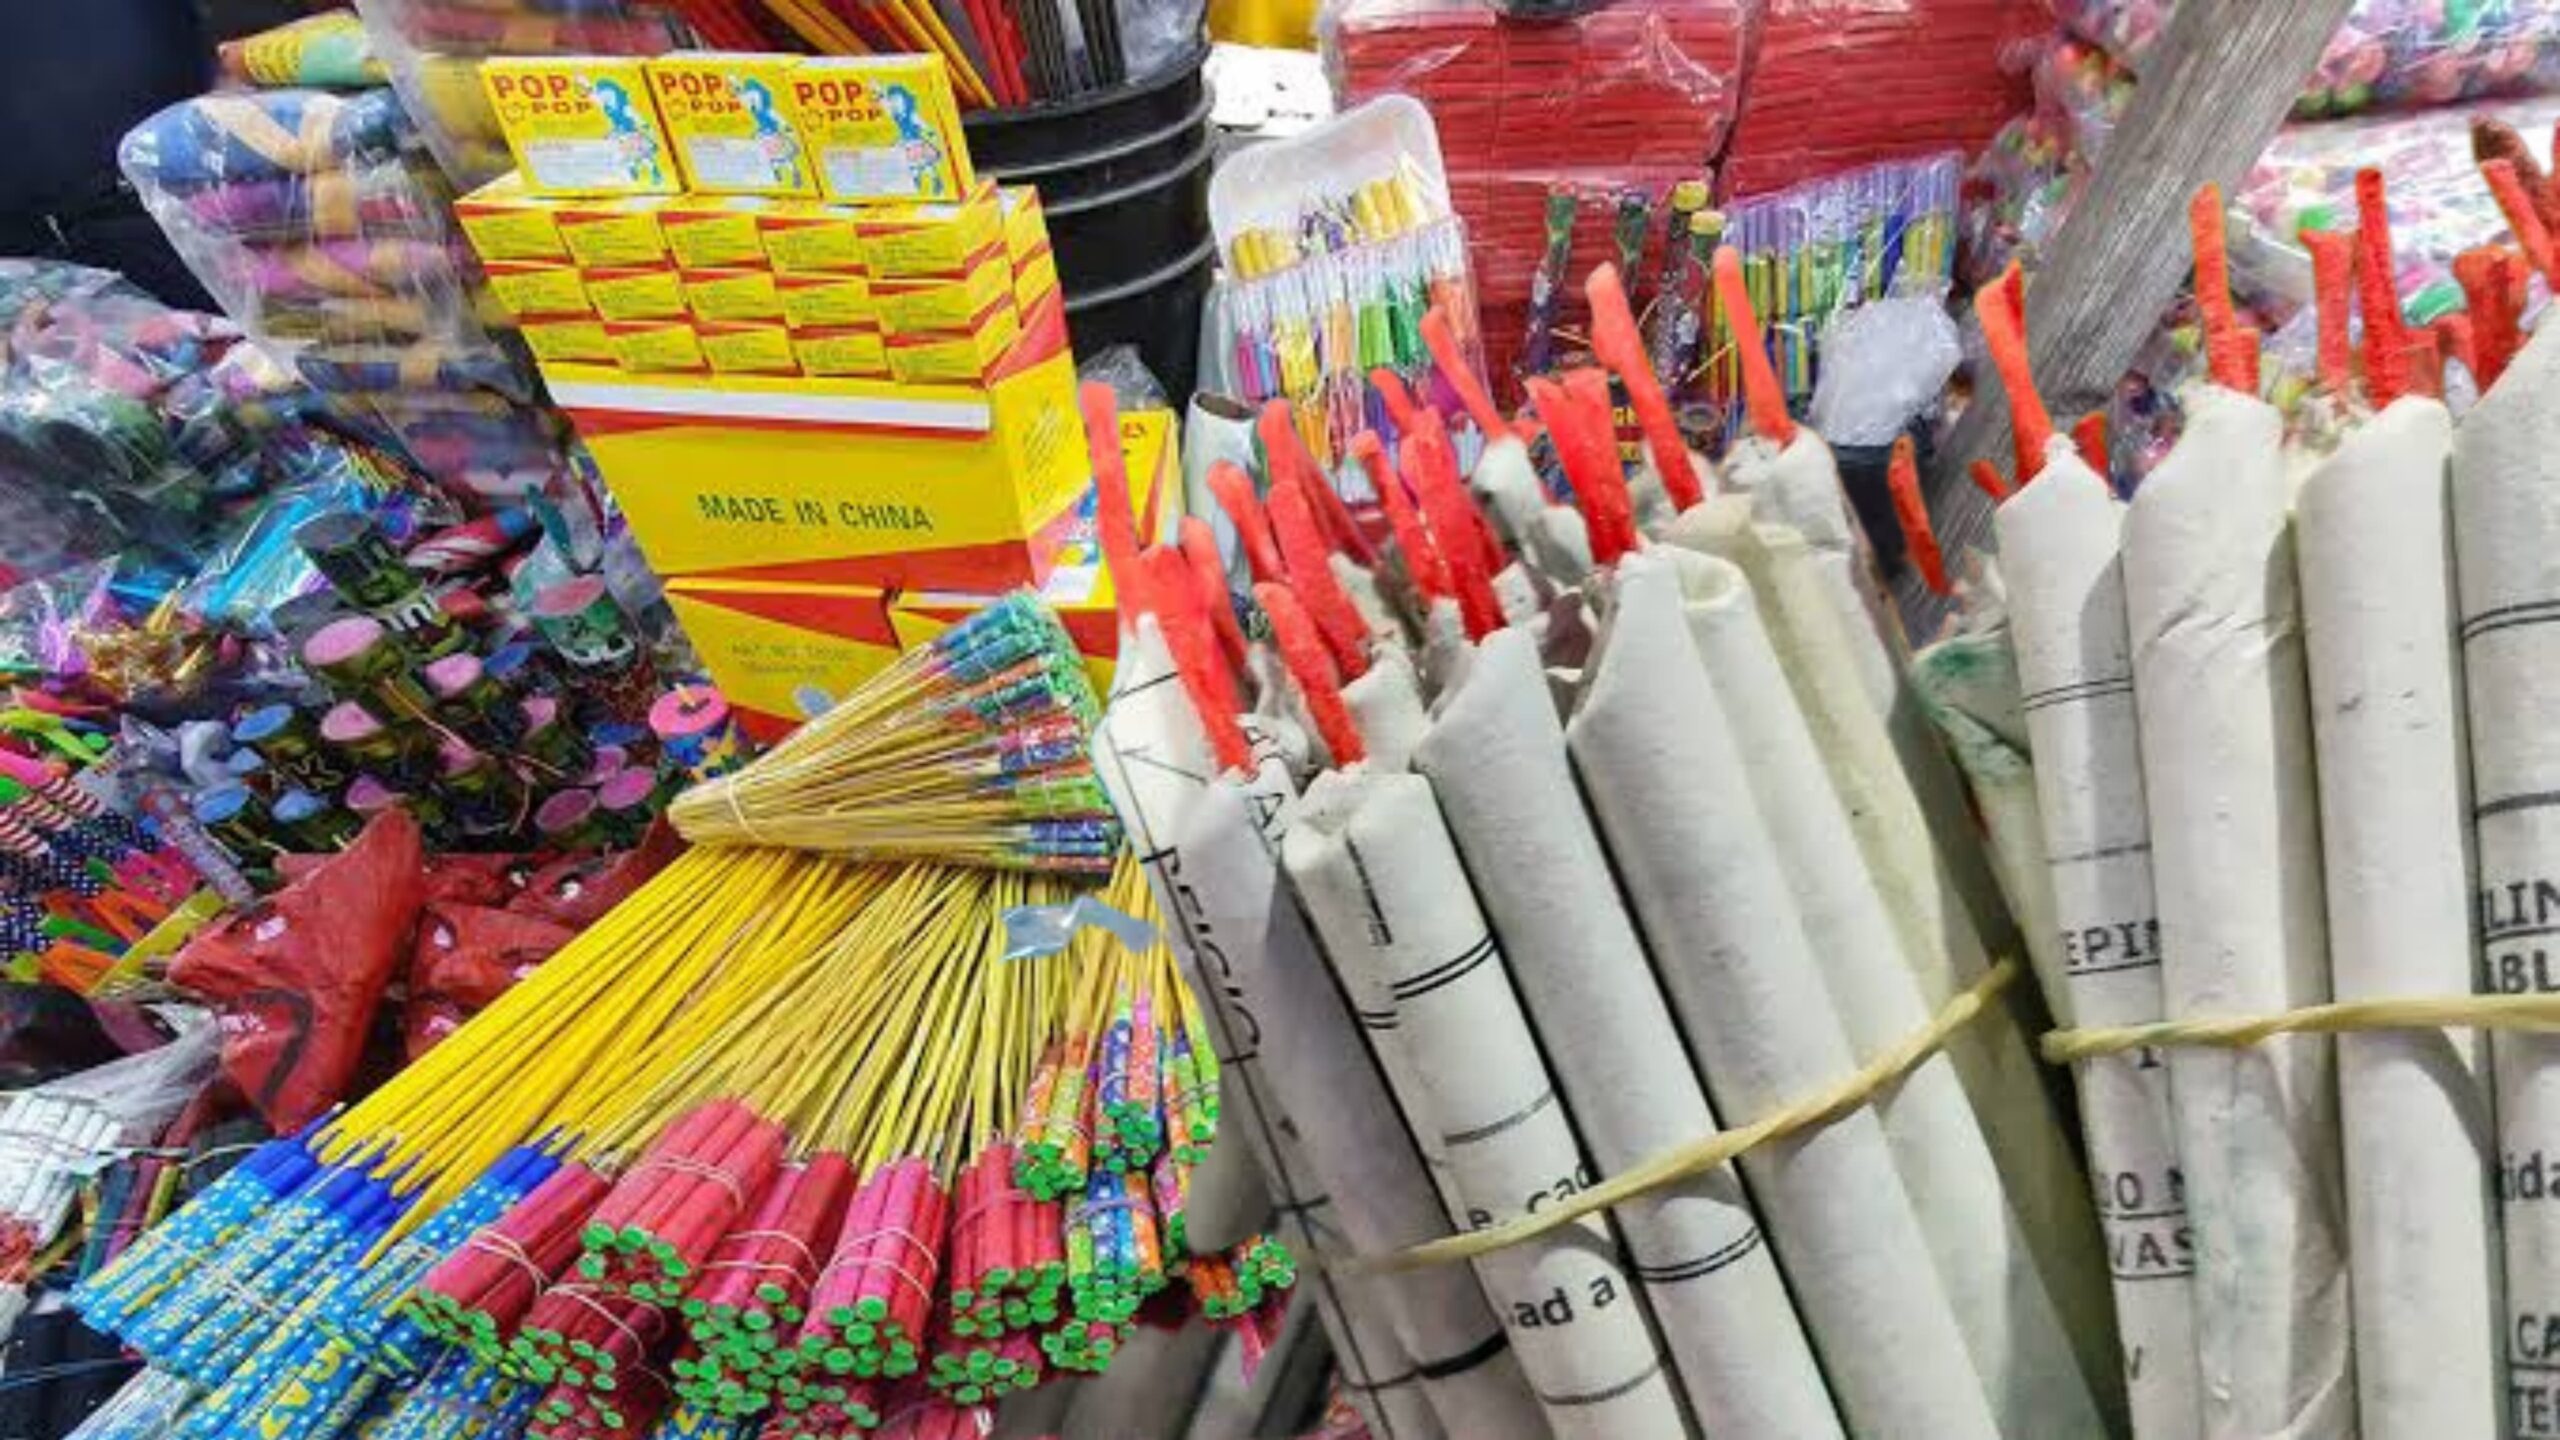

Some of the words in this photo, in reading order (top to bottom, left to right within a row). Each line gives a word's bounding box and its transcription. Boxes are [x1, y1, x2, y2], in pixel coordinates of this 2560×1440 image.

[491, 74, 567, 98] POP
[657, 72, 721, 96] POP
[794, 81, 862, 106] POP
[697, 494, 784, 523] MADE
[794, 500, 828, 526] IN
[838, 501, 934, 531] CHINA
